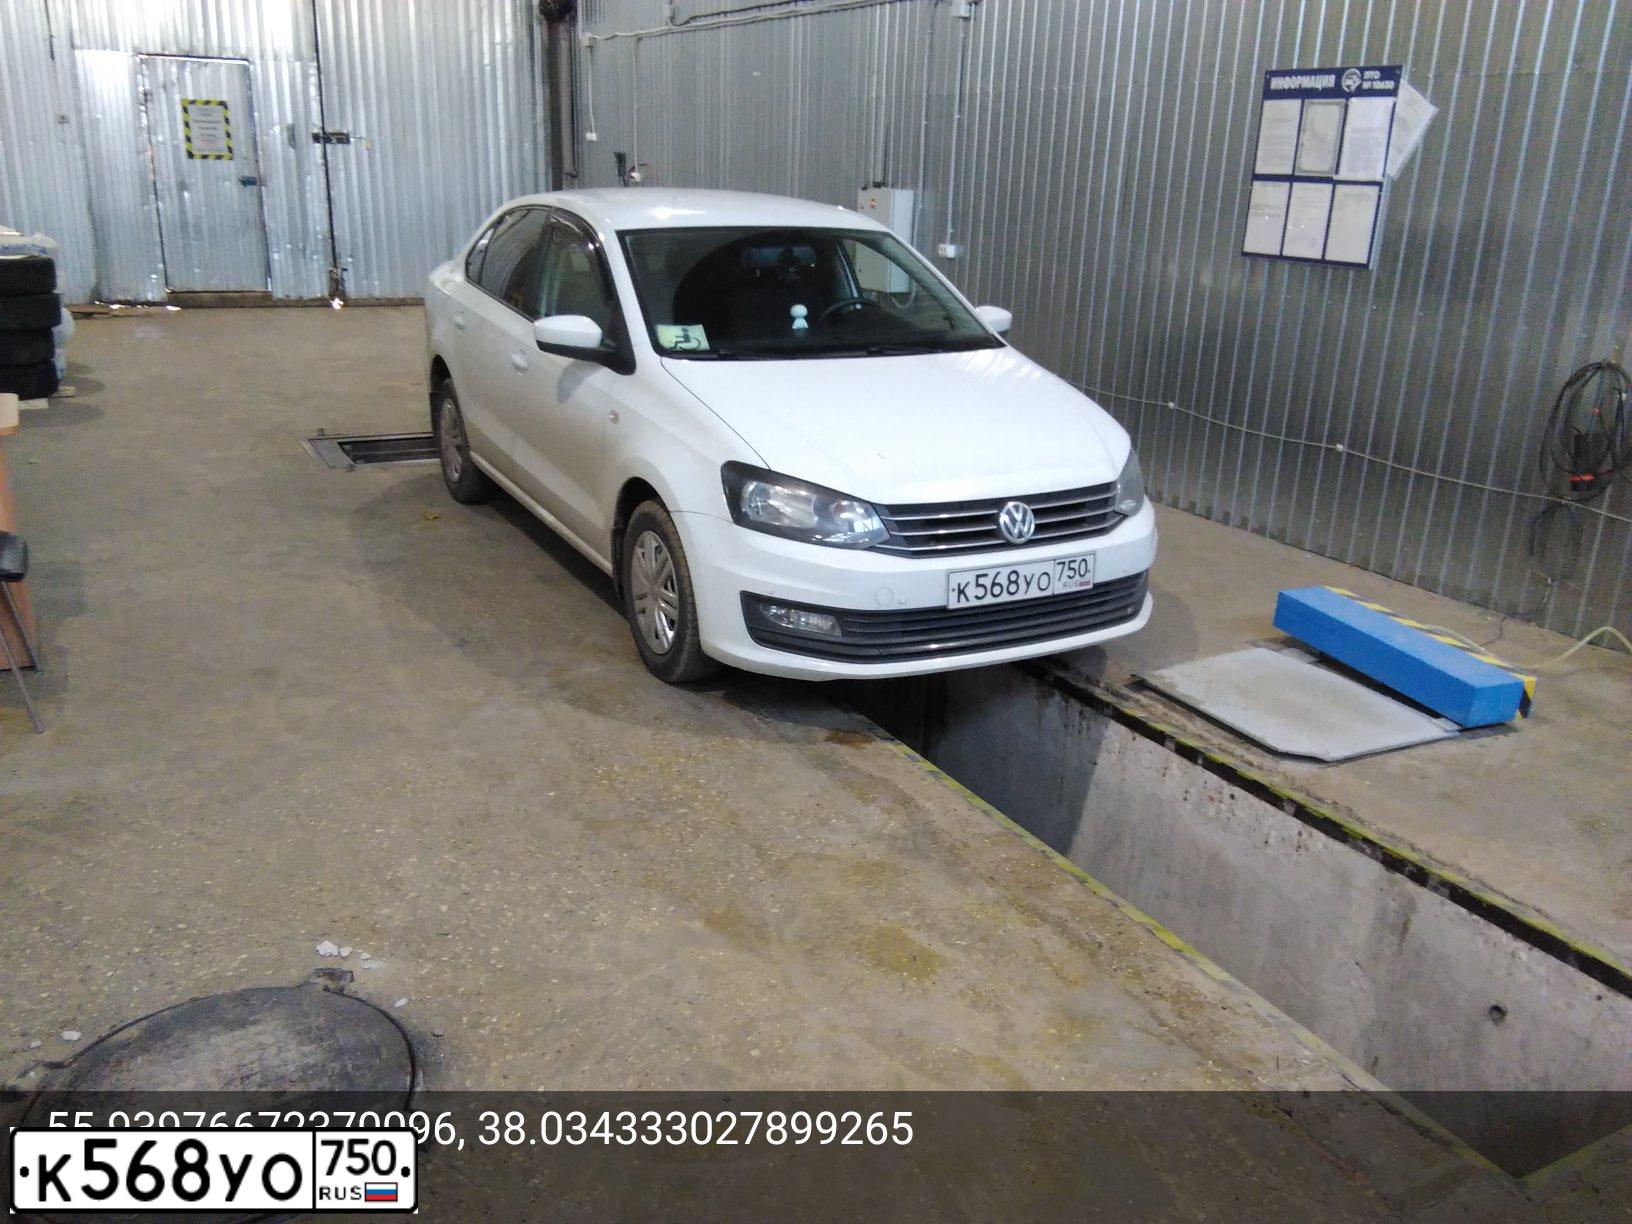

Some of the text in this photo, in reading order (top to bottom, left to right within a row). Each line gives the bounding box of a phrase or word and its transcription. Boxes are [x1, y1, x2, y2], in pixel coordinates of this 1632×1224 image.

[956, 557, 1088, 603] К568УО 750
[1063, 580, 1079, 588] RUS
